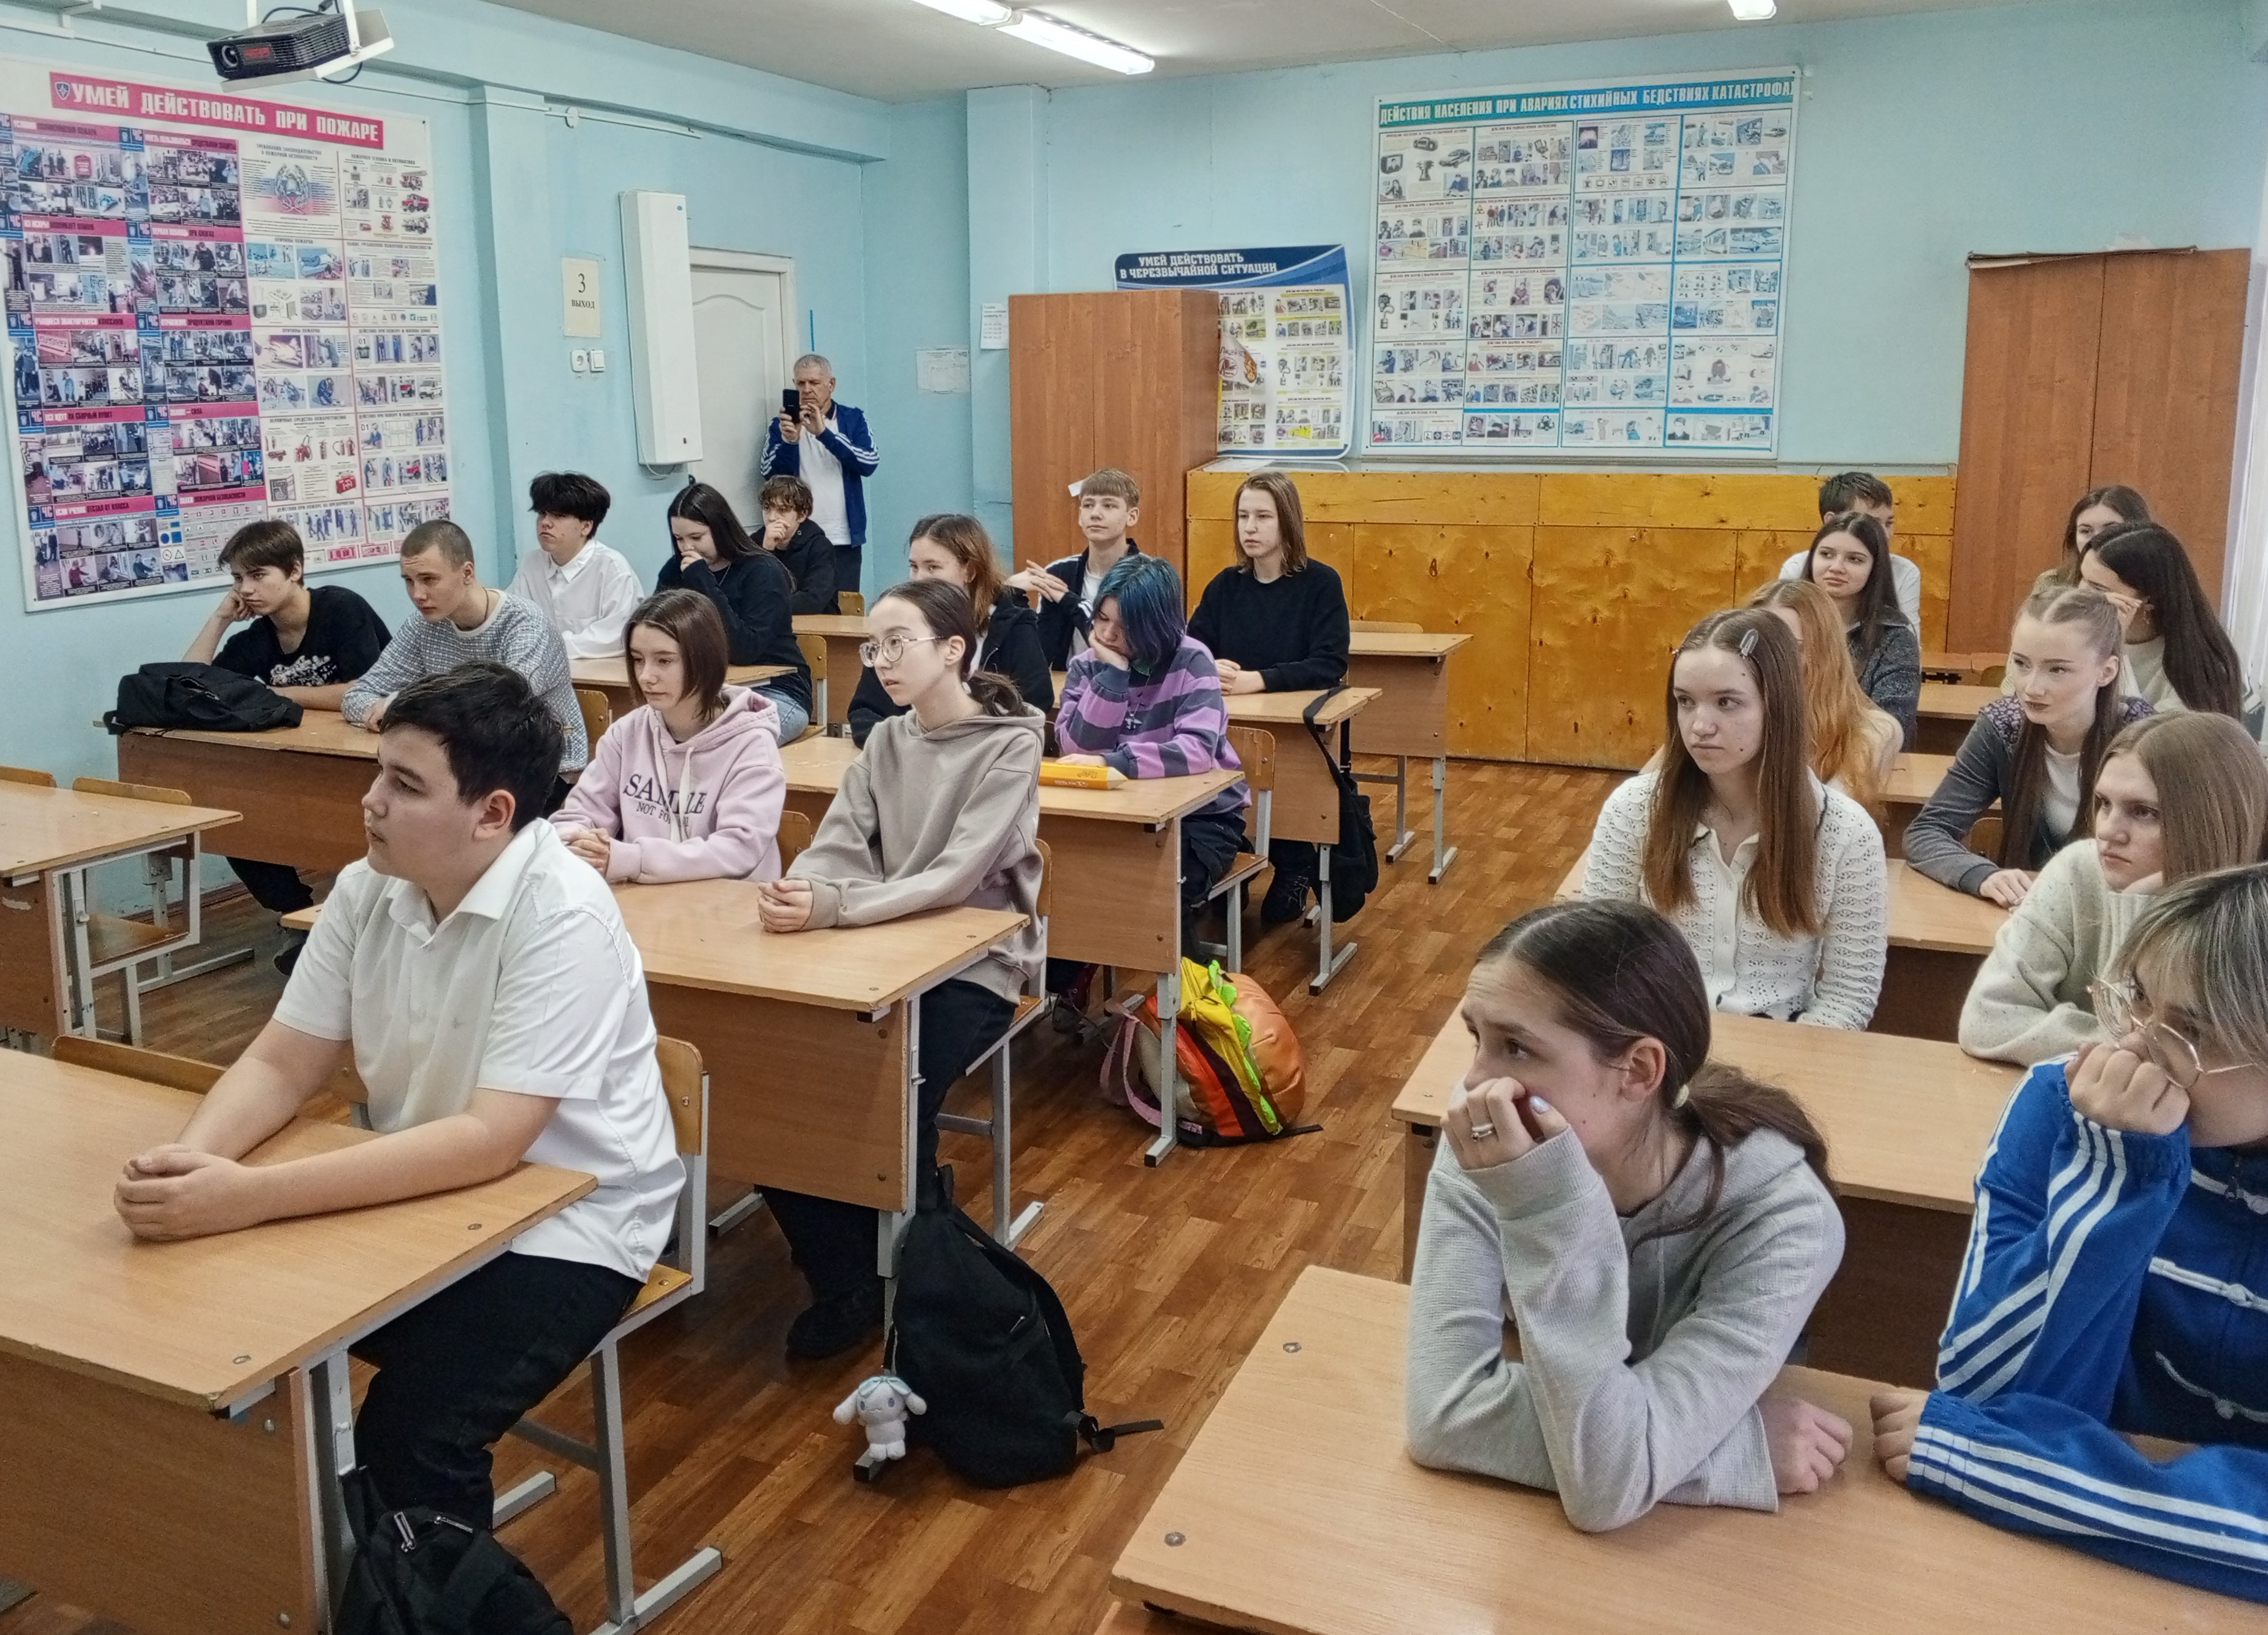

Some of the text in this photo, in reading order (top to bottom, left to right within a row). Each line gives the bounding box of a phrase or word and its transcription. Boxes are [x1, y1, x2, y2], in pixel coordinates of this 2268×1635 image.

[71, 83, 378, 142] УМЕЙ ДЕЙСТВОВАТЬ ПРИ ПОЖАРЕ
[1380, 104, 1431, 124] ДЕЙСТВИЯ
[1435, 100, 1492, 118] НАСЕЛЕНИЯ
[1495, 99, 1517, 113] ПРИ
[1520, 95, 1569, 112] АВАРИЯХ
[1570, 90, 1638, 109] СТИХИЙНЫХ
[1642, 86, 1709, 105] БЕДСТВИЯХ
[1138, 253, 1243, 267] УМЕЙ ДЕЙСТВОВАТЬ
[1120, 262, 1277, 278] В ЧЕРЕЗВЫЧАЙНОЙ СИТУАЦИИ
[578, 273, 586, 293] 3
[571, 299, 595, 309] ВЫХОД
[636, 801, 657, 816] NOT
